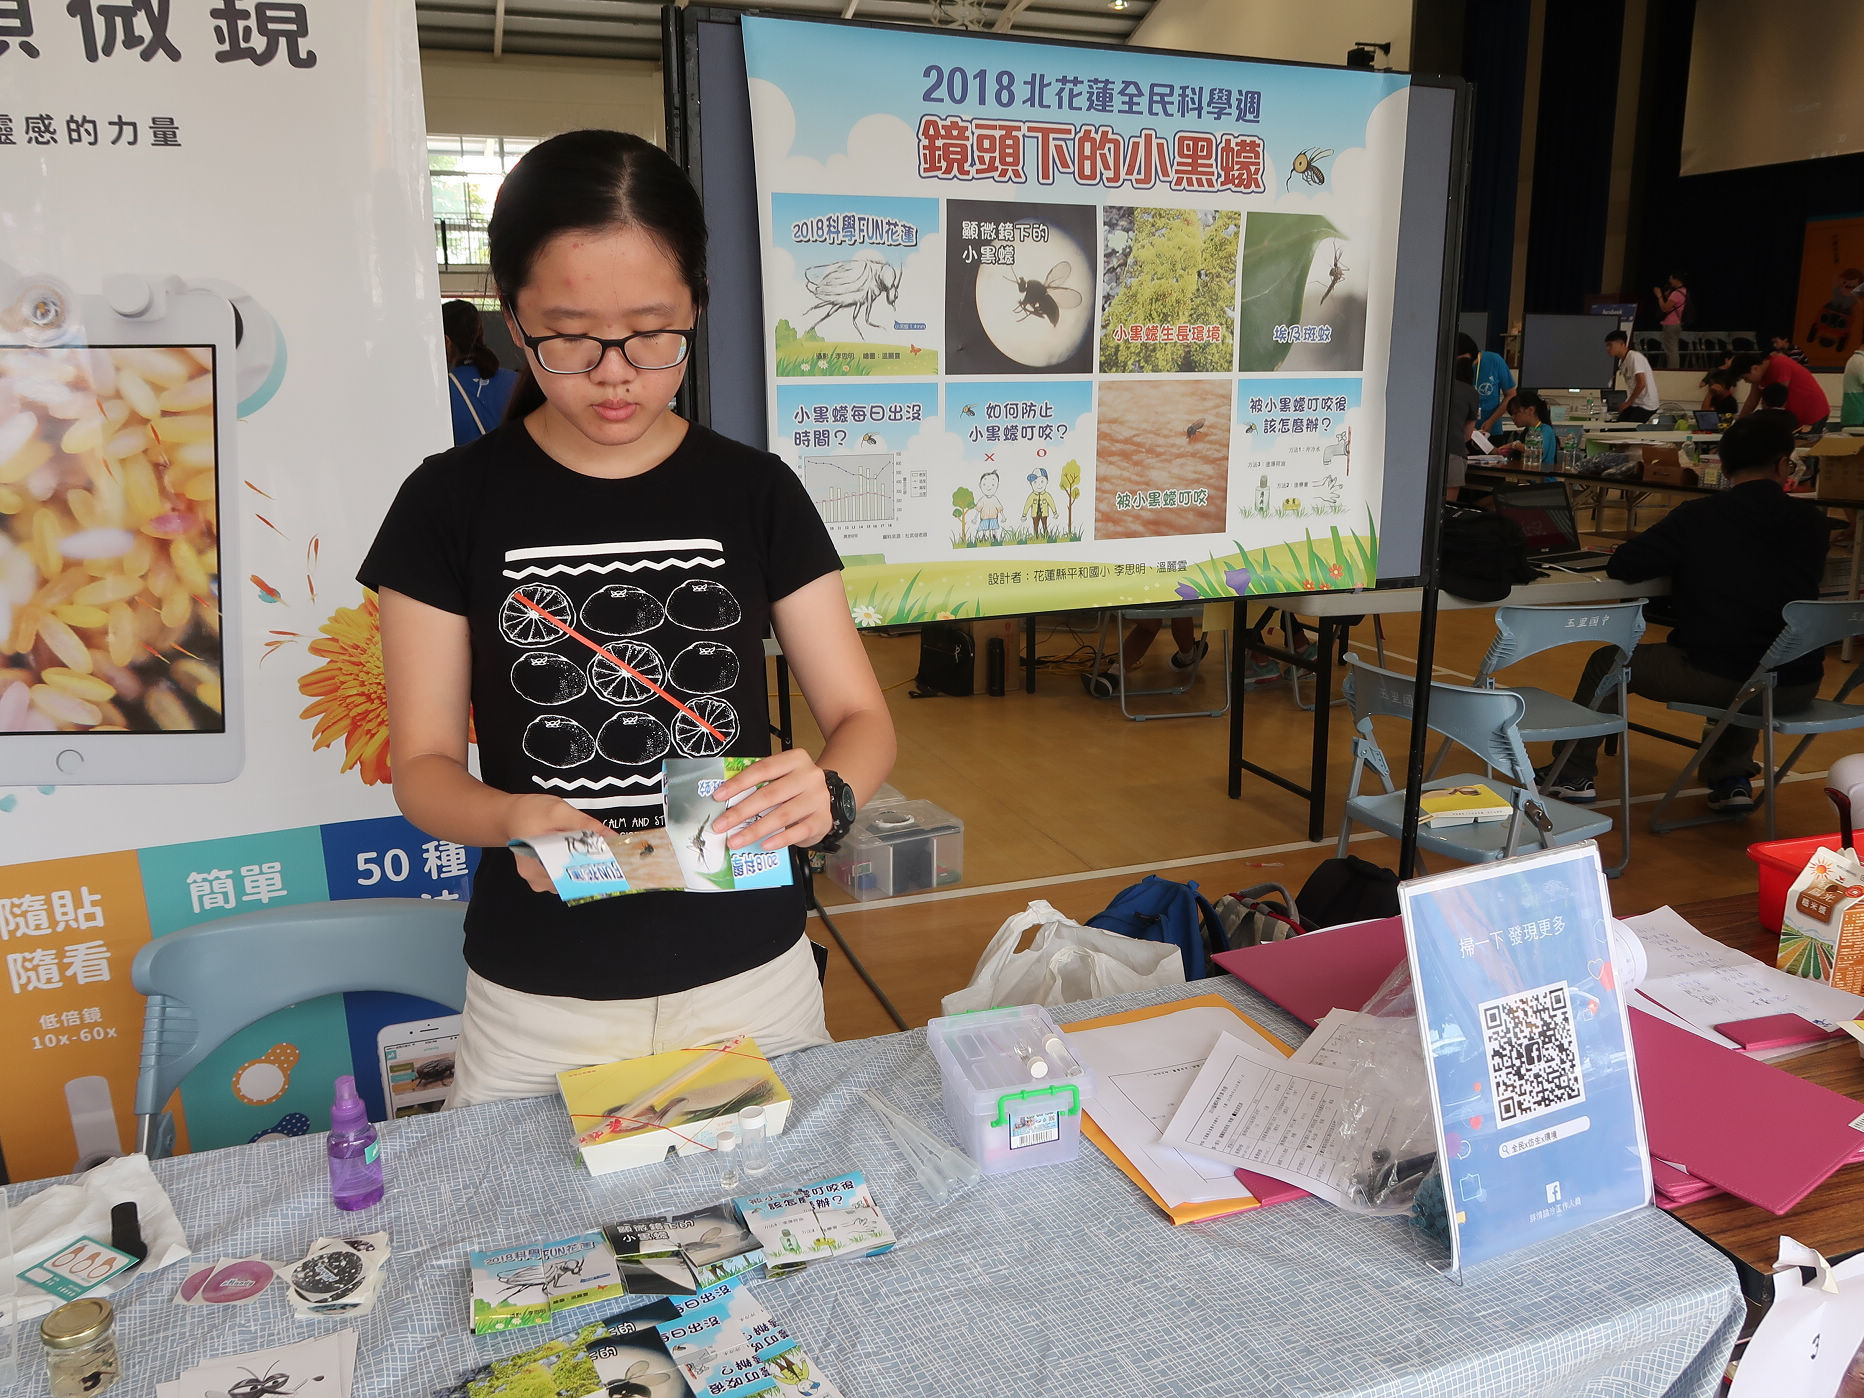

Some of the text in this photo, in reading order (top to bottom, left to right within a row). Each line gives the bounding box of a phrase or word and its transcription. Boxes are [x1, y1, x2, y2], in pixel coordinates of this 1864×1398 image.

[0, 0, 318, 69] 微鏡
[921, 64, 1263, 124] 2018北花蓮全民科學週
[918, 116, 1265, 193] 鏡頭下的小黑蠓
[792, 214, 917, 247] 2018科學FUN花蓮
[961, 221, 1049, 243] 顯微鏡下的
[962, 245, 1015, 265] 小黑蠓
[1113, 324, 1222, 343] 小黑蠓生長環境
[1273, 325, 1332, 343] 埃及斑蚊
[793, 404, 922, 424] 小黑蠓每日出沒
[985, 401, 1054, 420] 如何防止
[1250, 396, 1348, 413] 被小黑蠓叮咬後
[1116, 489, 1209, 510] 被小黑蠓叮咬
[603, 815, 665, 829] CALM AND ST
[356, 840, 469, 886] 50 種
[187, 862, 287, 913] 簡單
[0, 886, 105, 940] 隨貼
[1459, 916, 1566, 958] 掃一下 發現更多
[7, 940, 111, 994] 隨看
[39, 1007, 103, 1030] 低倍鏡
[32, 1026, 118, 1049] 10x-60x
